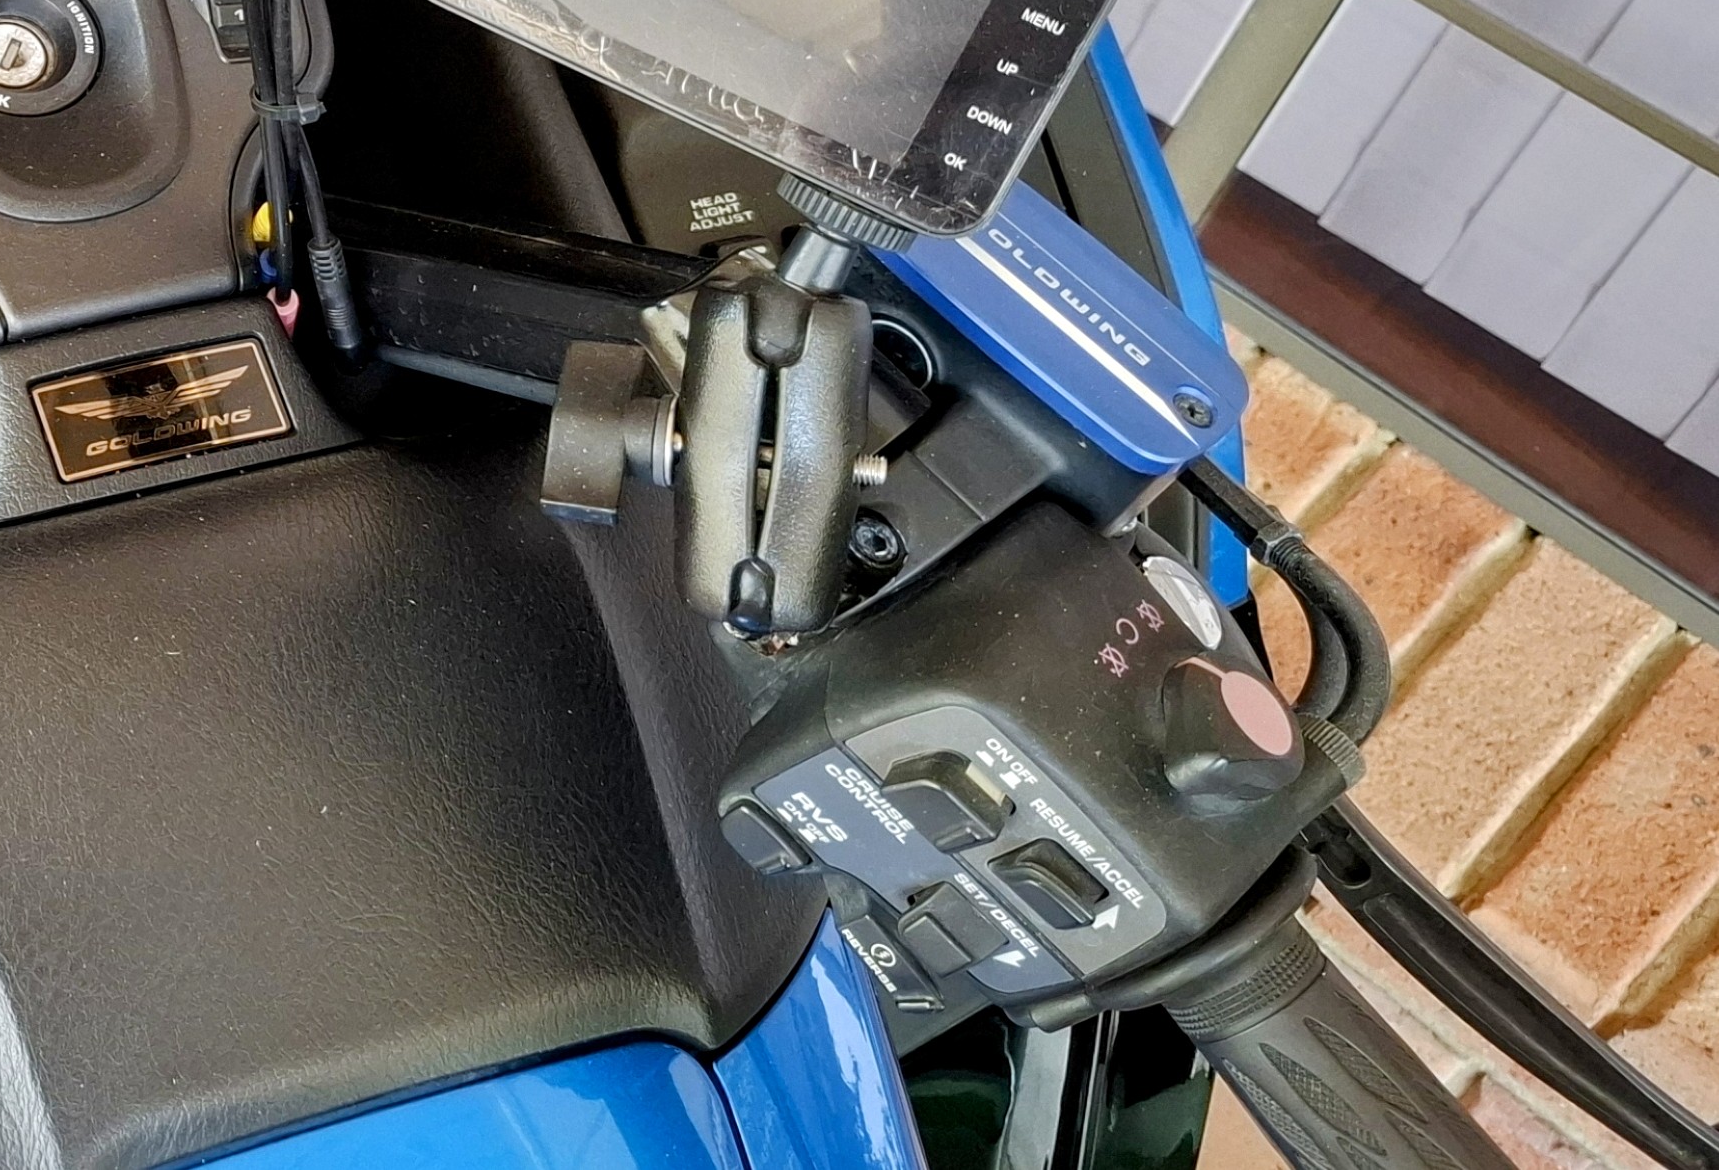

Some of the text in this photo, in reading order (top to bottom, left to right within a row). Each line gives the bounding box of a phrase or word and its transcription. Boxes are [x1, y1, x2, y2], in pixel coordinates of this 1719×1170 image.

[66, 1, 95, 54] IGNITION
[234, 9, 245, 21] 1
[1021, 7, 1066, 36] MENU
[996, 58, 1019, 77] UP
[966, 105, 1013, 134] DOWN
[943, 152, 967, 171] OK
[689, 192, 738, 210] HEAD
[689, 210, 754, 232] ADJUST
[692, 202, 740, 220] LIGHT
[987, 228, 1151, 367] OLDWING
[86, 408, 252, 457] GOLDWING
[986, 738, 1038, 785] ON OFF
[783, 801, 831, 843] ON OFF
[791, 792, 848, 842] RVS
[824, 763, 906, 845] CONTROL
[844, 767, 915, 832] CRUISE
[1030, 798, 1144, 909] RESUME/ACCEL
[953, 872, 1040, 958] SET/DECEL
[841, 929, 897, 993] REVERSE
